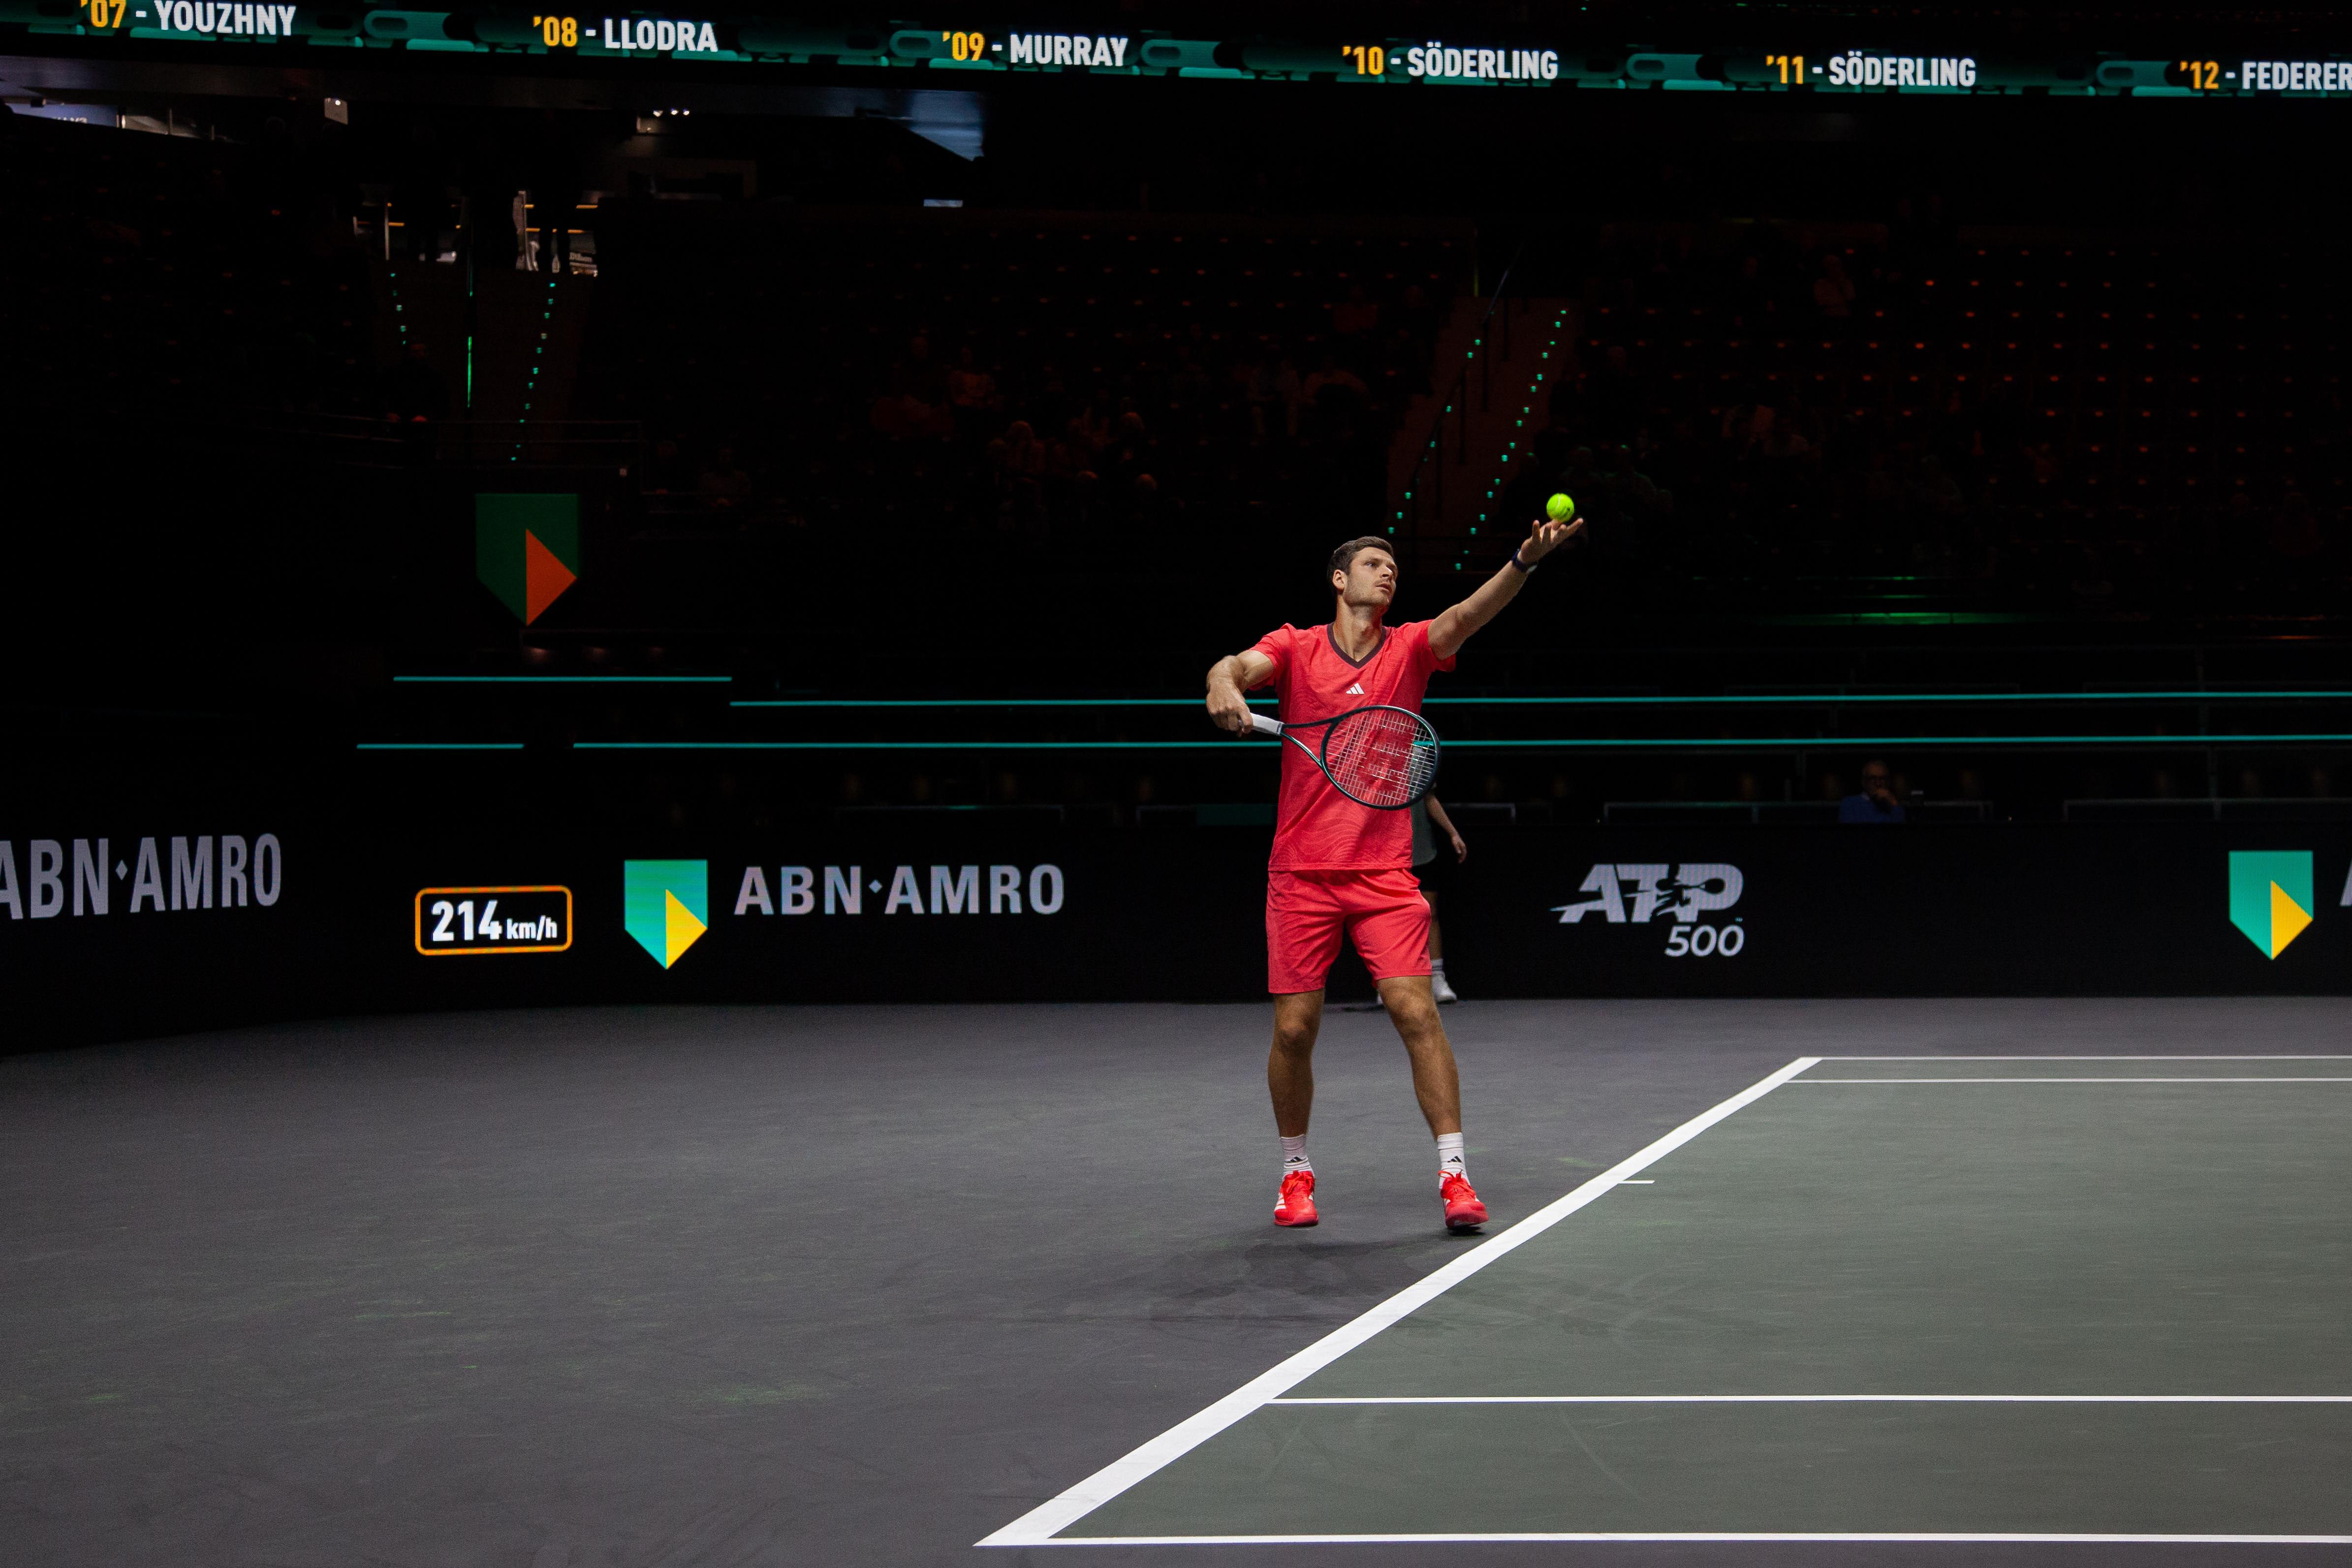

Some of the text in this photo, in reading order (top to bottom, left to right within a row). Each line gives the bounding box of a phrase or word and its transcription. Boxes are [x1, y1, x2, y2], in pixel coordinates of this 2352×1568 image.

[80, 0, 127, 28] '07
[154, 0, 296, 36] YOUZHNY
[533, 16, 578, 48] '08
[604, 18, 719, 53] LLODRA
[942, 31, 985, 62] '09
[1010, 33, 1129, 67] MURRAY
[1342, 45, 1384, 76] '10
[1407, 41, 1559, 80] SÖDERLING
[1766, 55, 1804, 85] '11
[1828, 50, 1976, 87] SÖDERLING
[2180, 61, 2220, 90] '12
[2242, 62, 2352, 91] FEDERER
[1550, 863, 1744, 923] ATP
[431, 899, 558, 942] 214 km/h
[1665, 925, 1745, 957] 500
